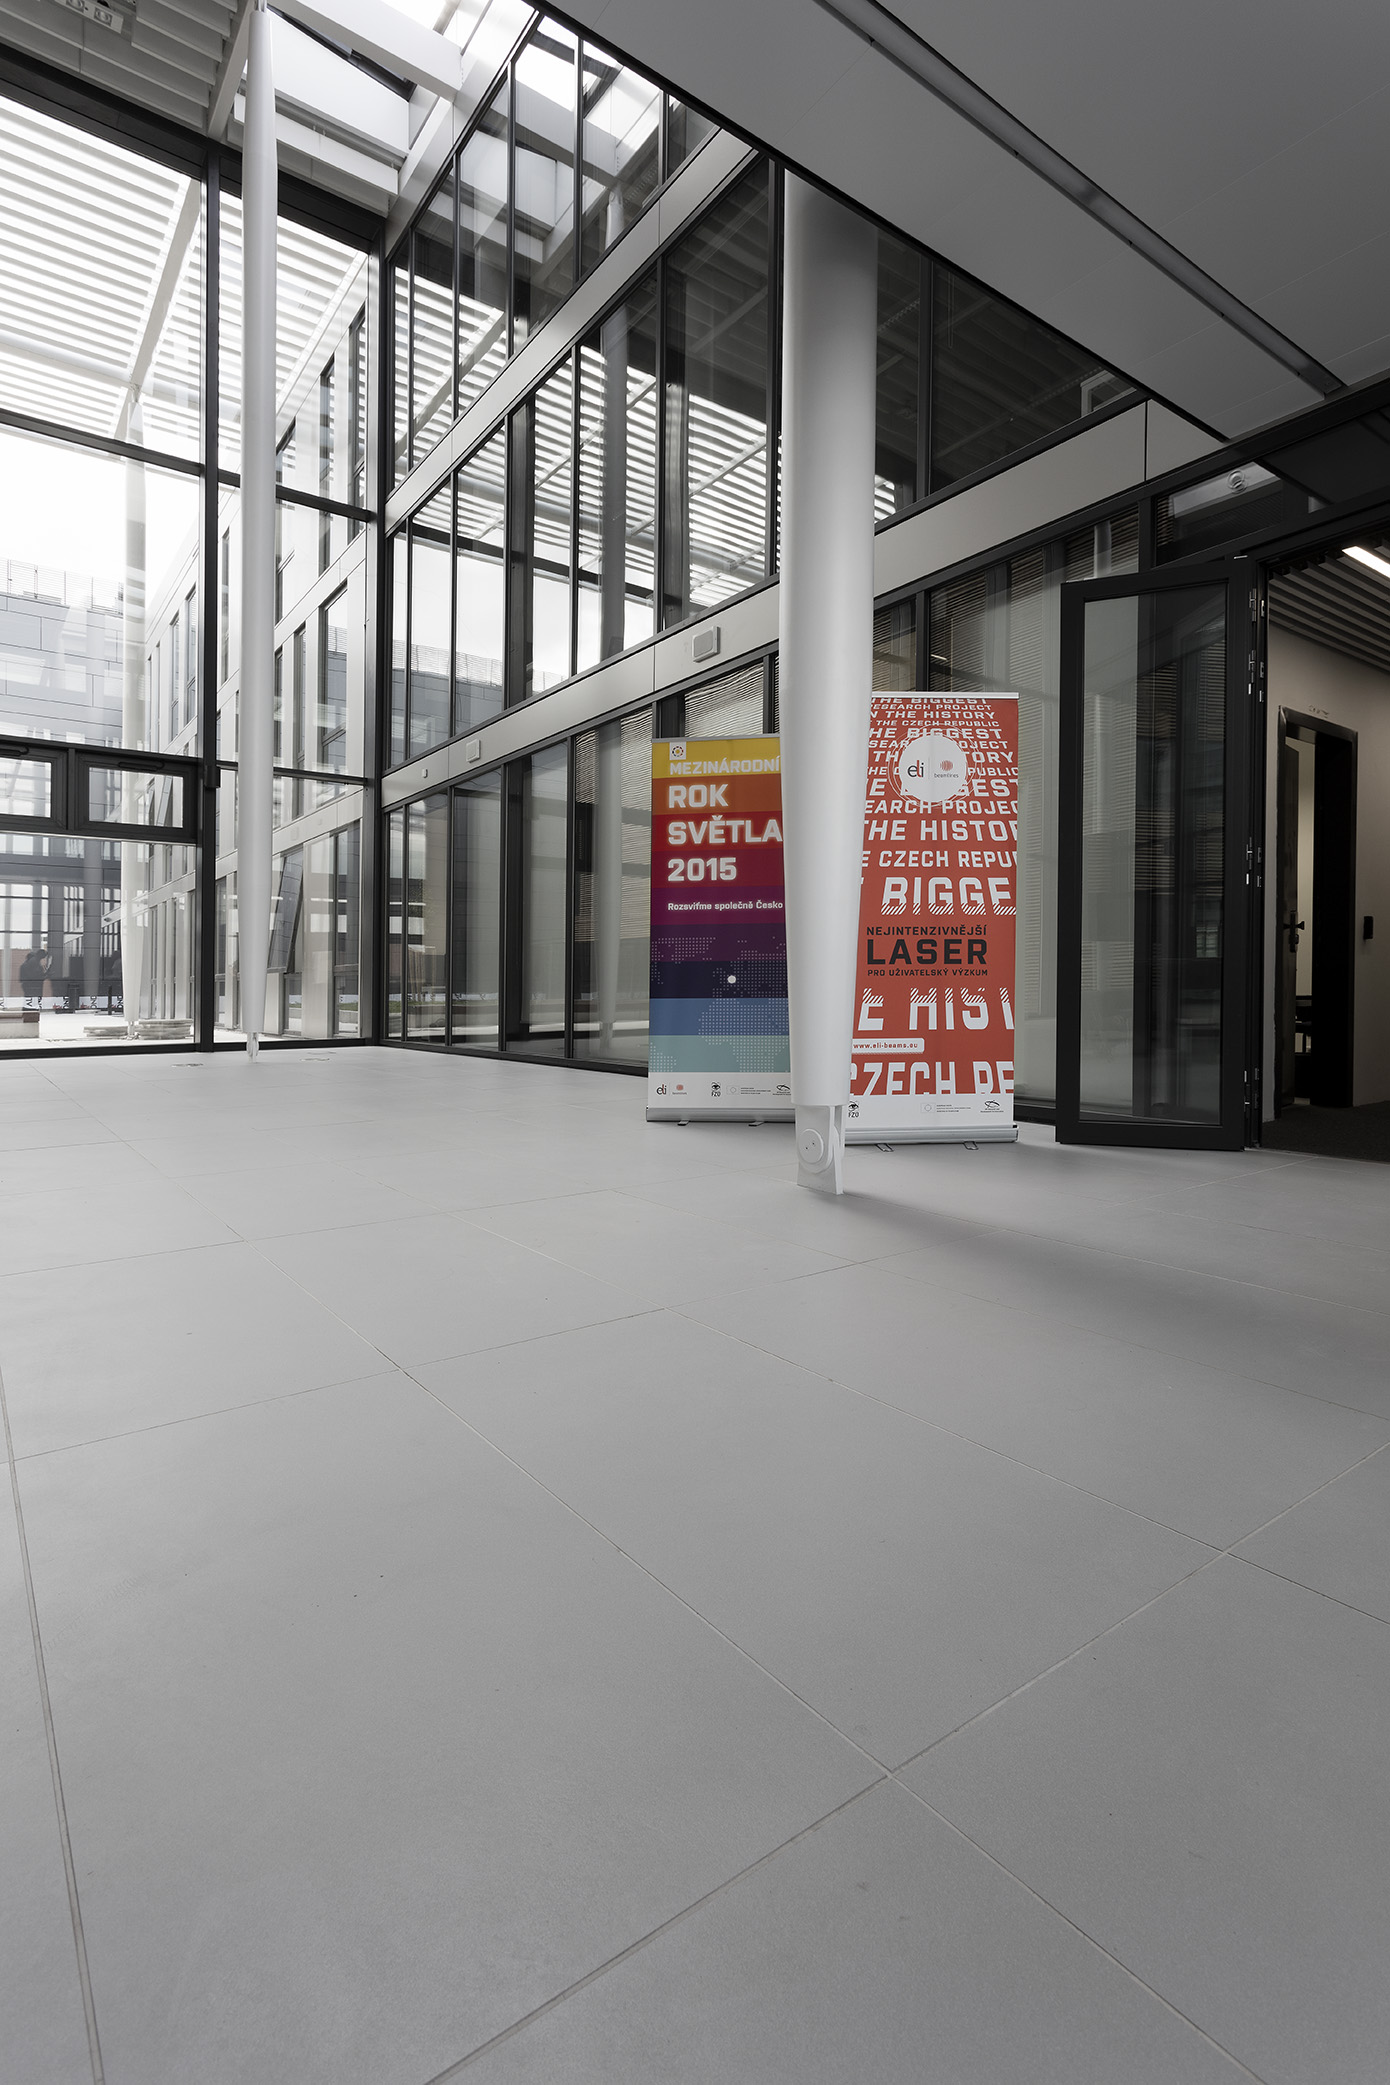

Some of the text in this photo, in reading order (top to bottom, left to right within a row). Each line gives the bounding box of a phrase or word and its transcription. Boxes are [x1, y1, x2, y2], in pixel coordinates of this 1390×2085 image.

[923, 711, 995, 719] HISTORY
[669, 756, 780, 775] MEZINÁRODNÍ
[907, 760, 924, 777] eli
[668, 783, 729, 808] ROK
[668, 815, 783, 845] SVĚTLA
[879, 850, 949, 867] CZECH
[668, 857, 737, 882] 2015
[755, 900, 783, 909] Česko
[866, 924, 987, 936] NEJINTENZIVNĚJŠÍ
[867, 939, 987, 965] LASER
[867, 968, 988, 977] PRO UŽIVATELSKÝ VÝZKUM
